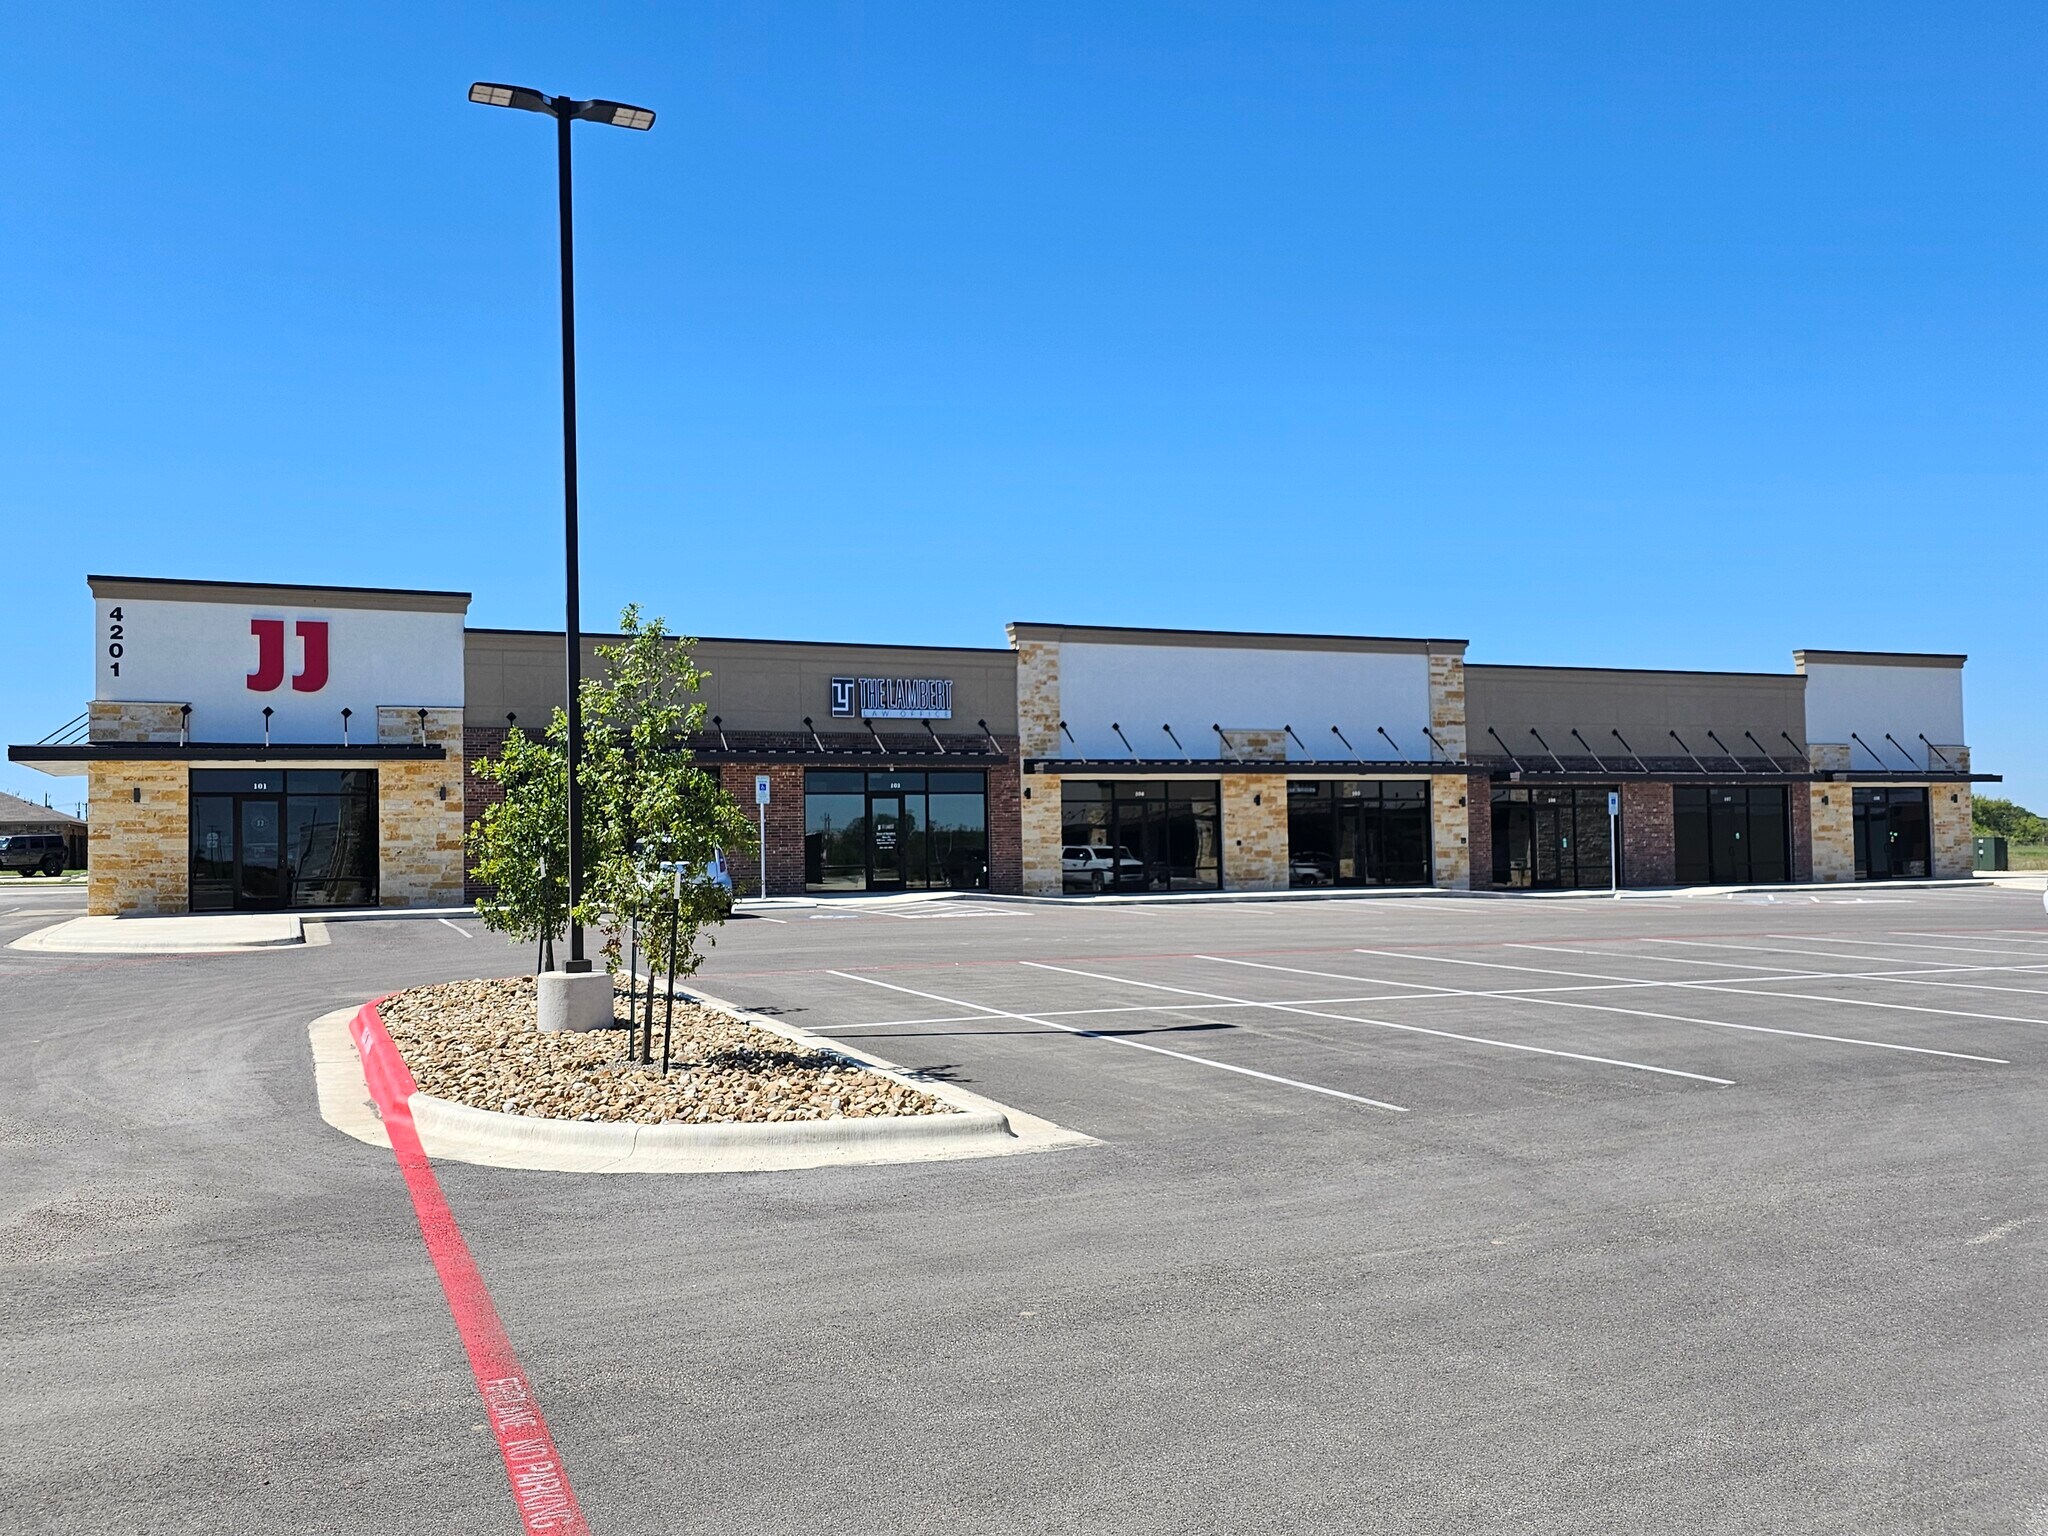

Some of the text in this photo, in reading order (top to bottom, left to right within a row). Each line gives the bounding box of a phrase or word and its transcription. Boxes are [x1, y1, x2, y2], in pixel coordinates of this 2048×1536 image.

[108, 606, 124, 677] 4201
[246, 619, 329, 692] JJ
[858, 678, 885, 708] THE
[886, 679, 953, 709] LAMBERT
[900, 710, 950, 718] OFFICE
[505, 1437, 548, 1460] NO
[513, 1460, 573, 1529] PARKING
